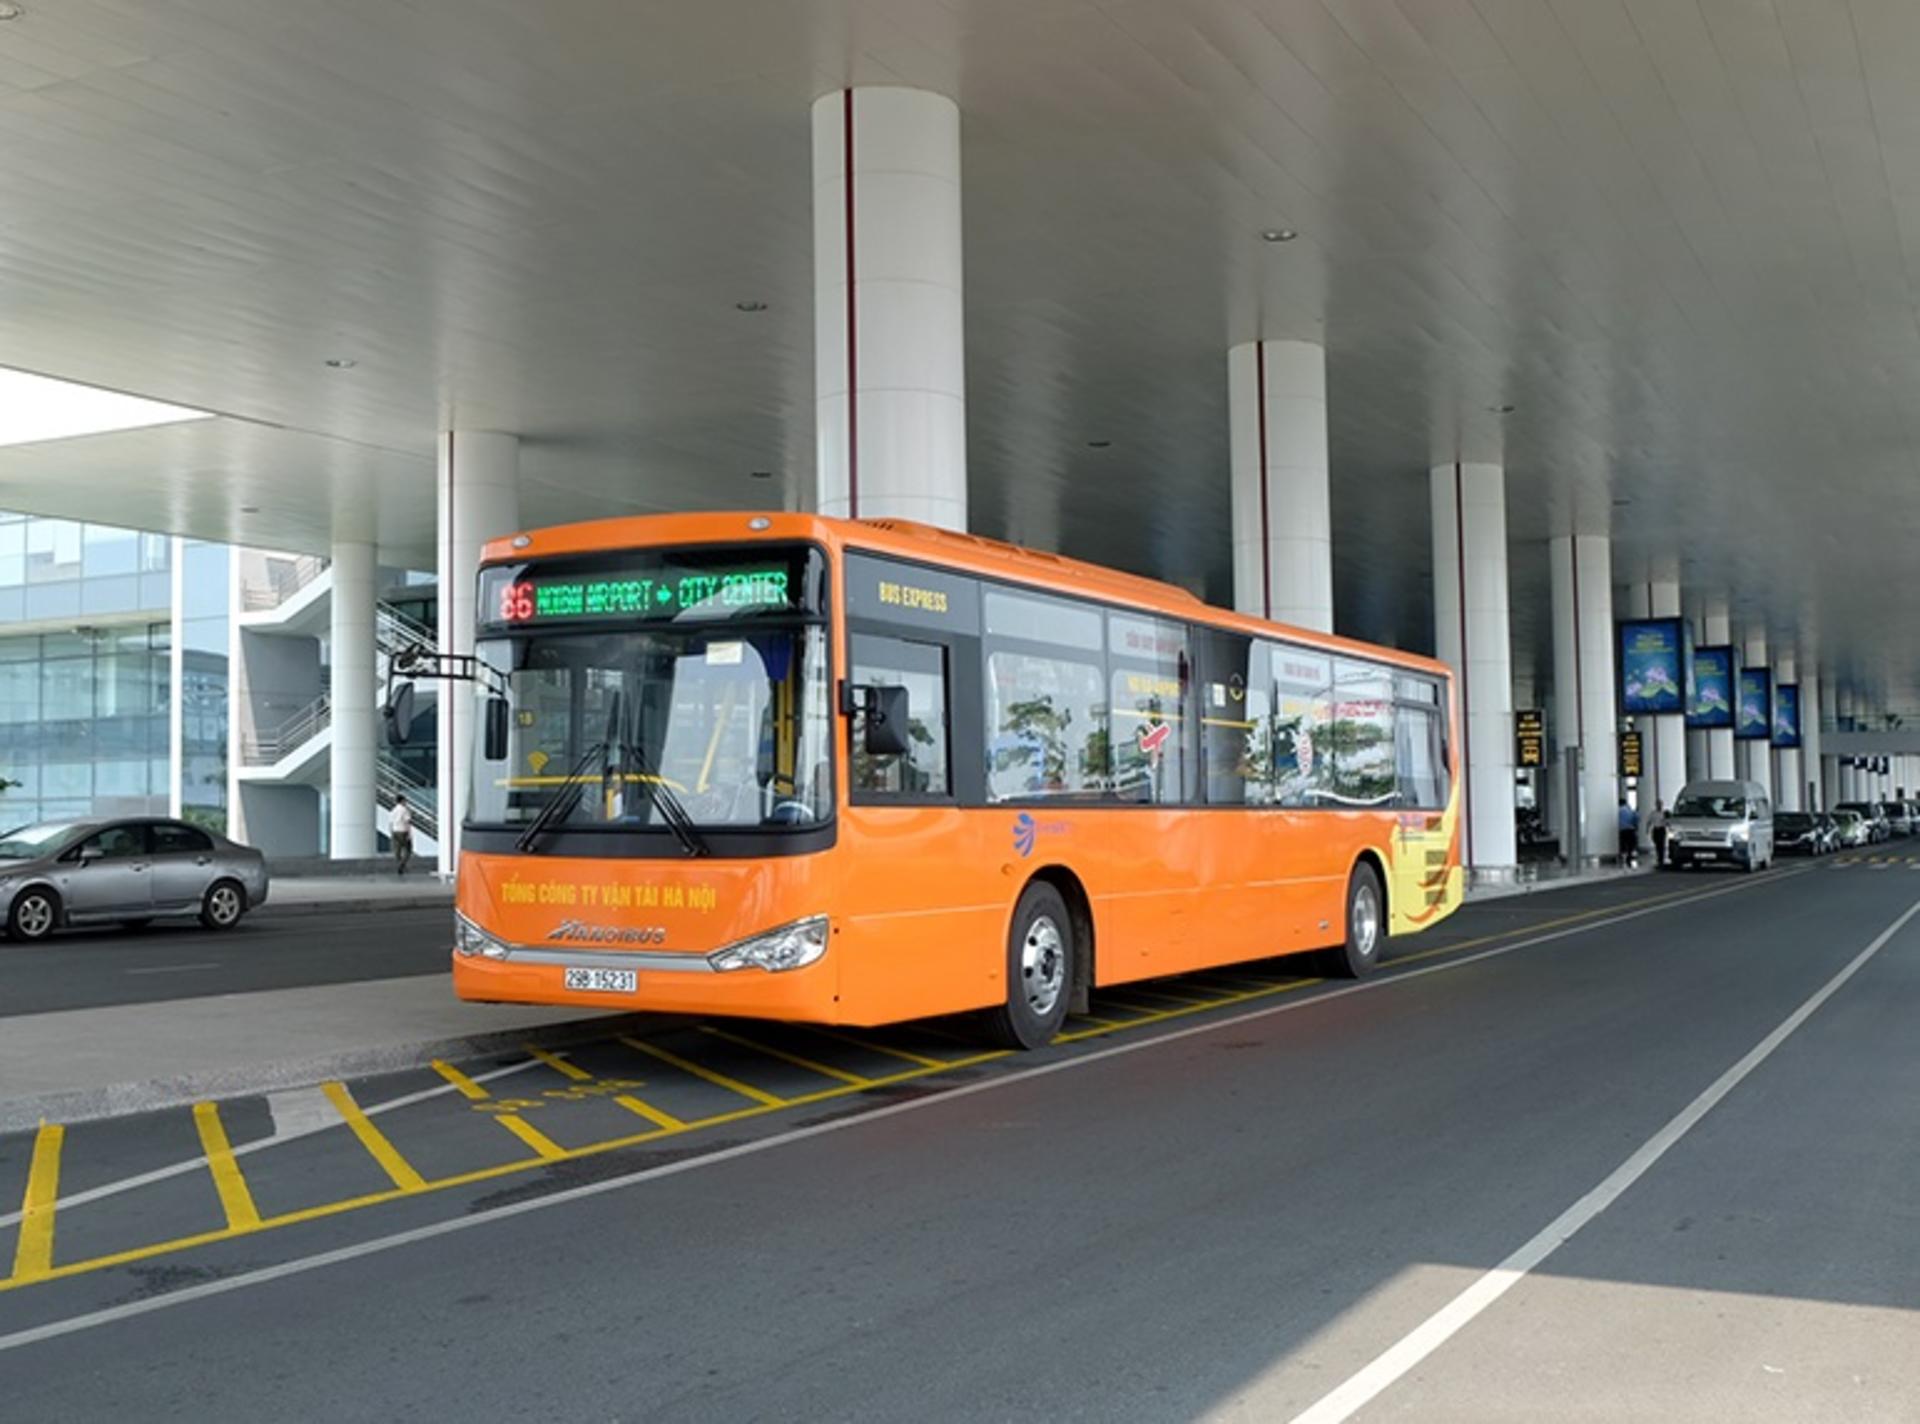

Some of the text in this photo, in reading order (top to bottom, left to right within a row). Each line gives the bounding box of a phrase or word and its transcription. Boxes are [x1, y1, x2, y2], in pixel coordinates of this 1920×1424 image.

[500, 582, 534, 619] 86
[586, 580, 653, 612] AIRPORT
[679, 576, 717, 608] CITY
[722, 571, 789, 606] CENTER
[879, 581, 948, 613] BUS EXPRESS
[538, 879, 576, 905] CÔNG
[581, 884, 599, 905] TY
[602, 881, 631, 911] VẬN
[688, 882, 717, 914] NỘI
